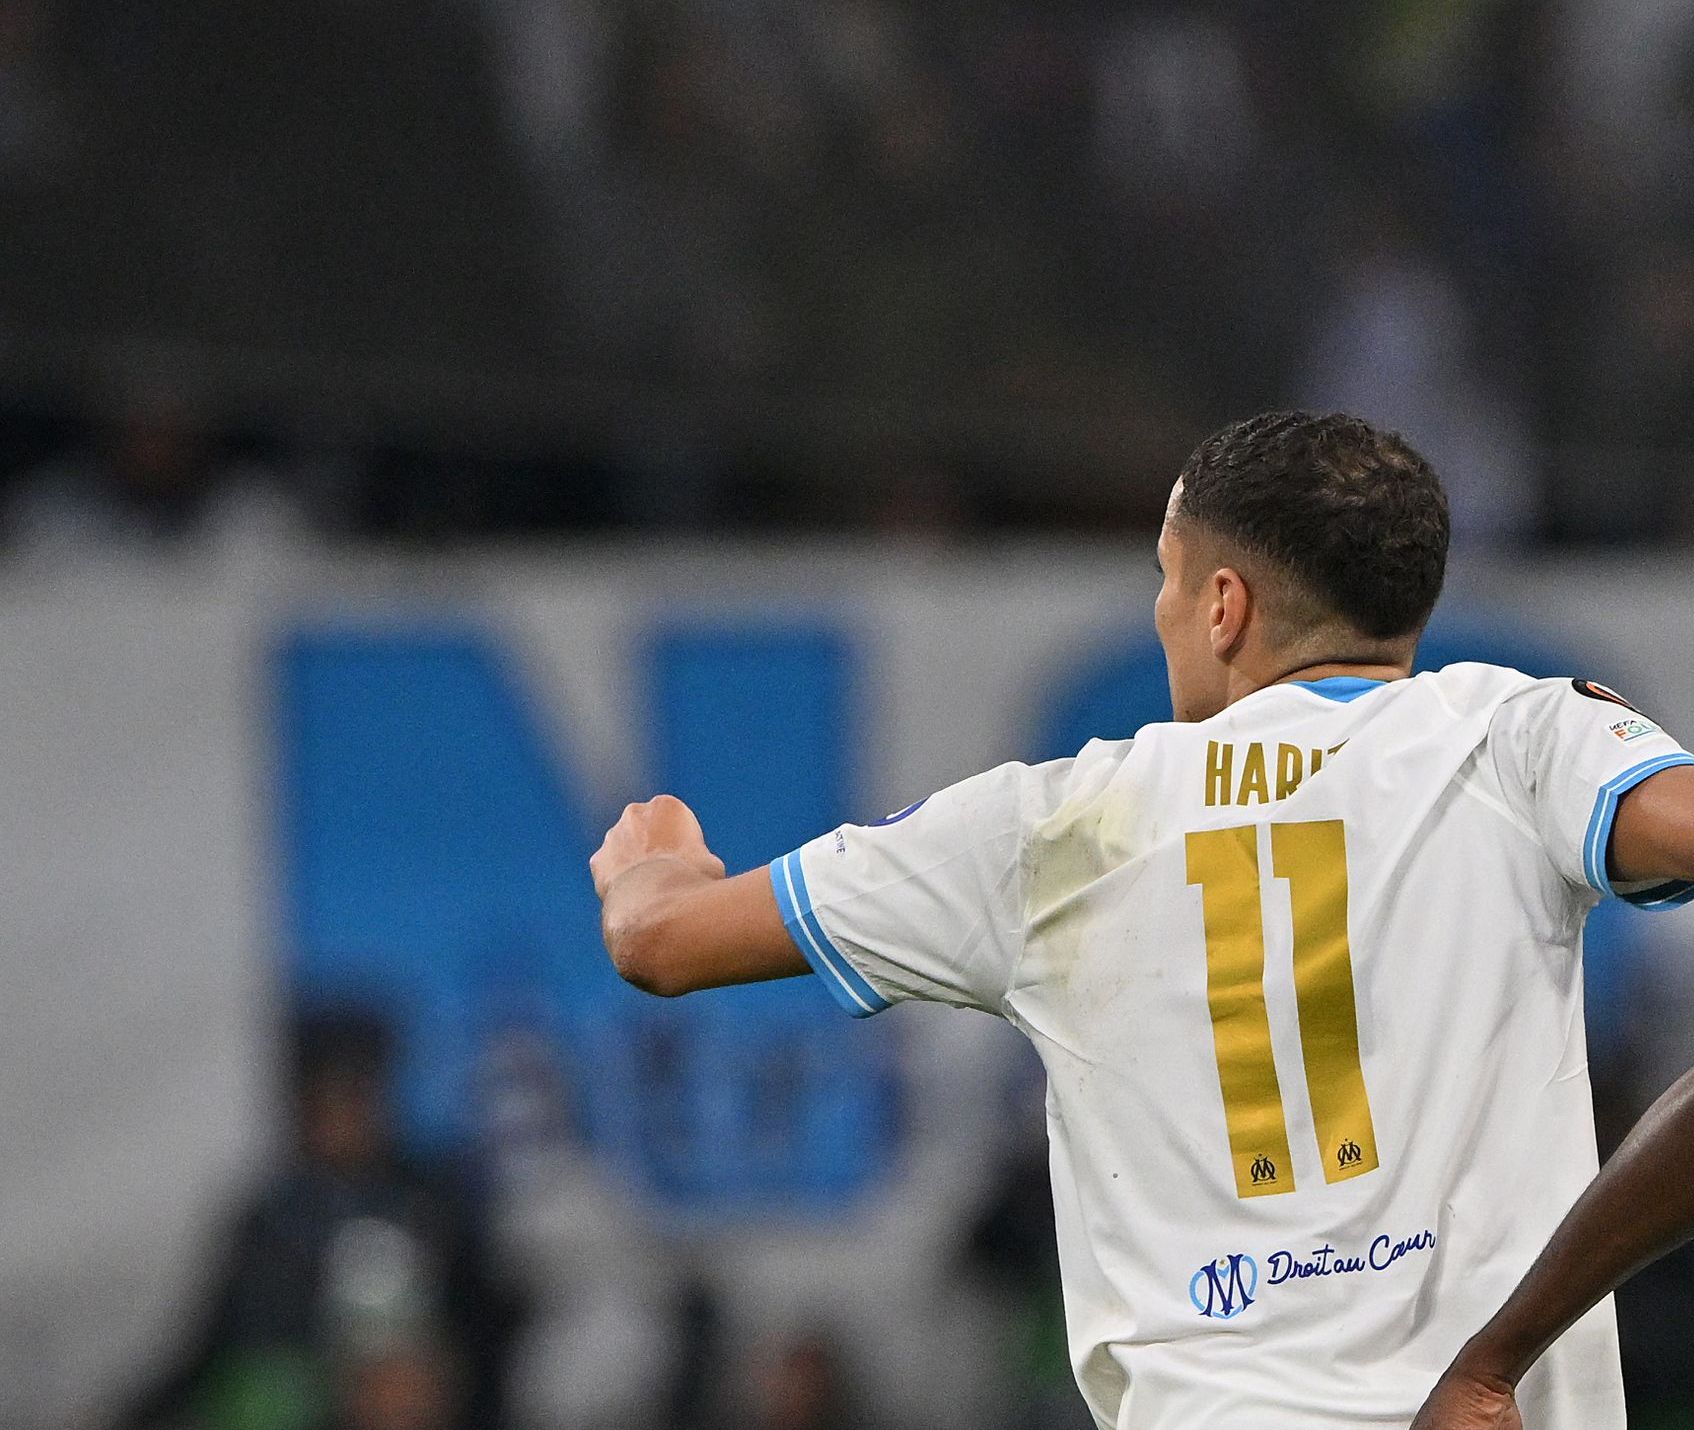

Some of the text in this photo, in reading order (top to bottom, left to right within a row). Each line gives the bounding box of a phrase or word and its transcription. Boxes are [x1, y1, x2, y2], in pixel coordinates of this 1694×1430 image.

[1204, 739, 1350, 807] HAR
[1184, 819, 1381, 1199] 11
[1267, 1244, 1335, 1285] Droit
[1333, 1256, 1366, 1274] au
